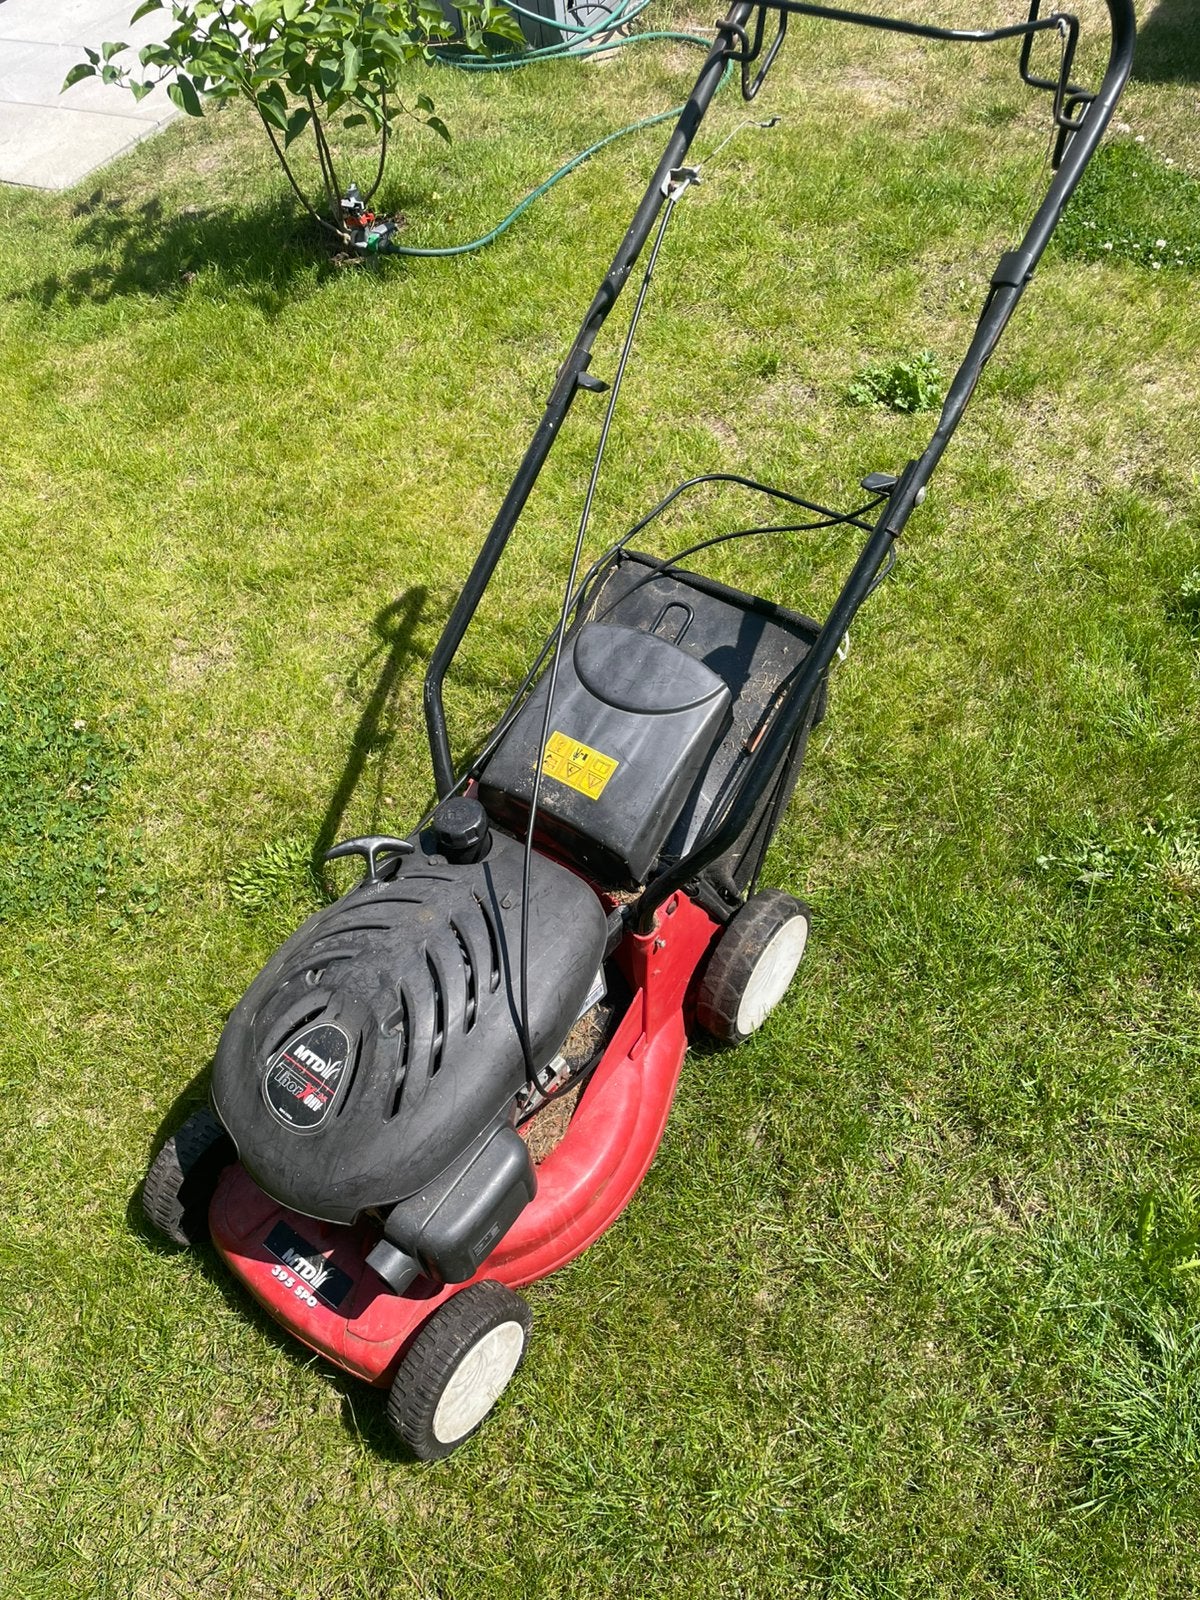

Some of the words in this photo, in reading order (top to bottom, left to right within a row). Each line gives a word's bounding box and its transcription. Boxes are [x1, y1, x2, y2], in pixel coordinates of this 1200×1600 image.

[293, 1044, 326, 1071] MTD
[281, 1248, 316, 1279] MTD
[271, 1265, 296, 1287] 395
[294, 1286, 318, 1308] SPO
